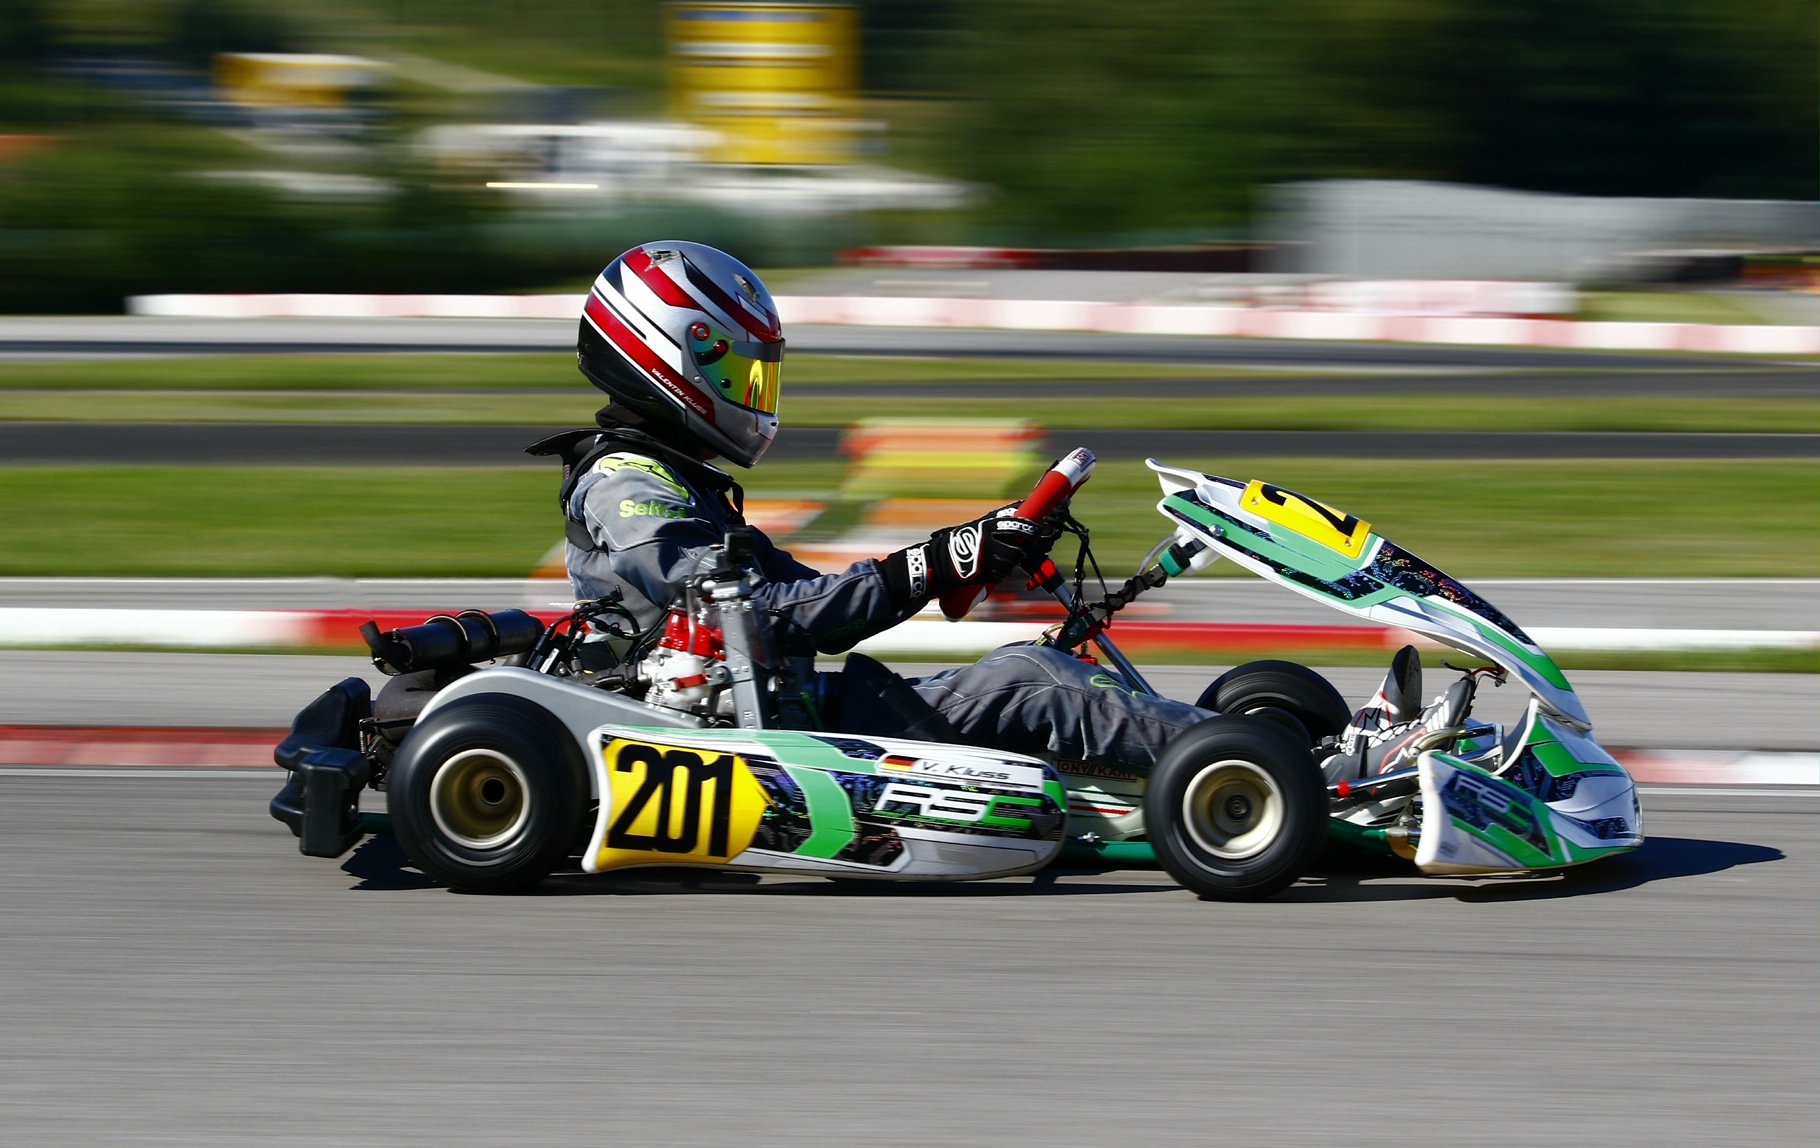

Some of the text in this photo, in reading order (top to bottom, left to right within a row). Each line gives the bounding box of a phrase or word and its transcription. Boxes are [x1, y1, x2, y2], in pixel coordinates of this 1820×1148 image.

[651, 368, 708, 415] VALENTIN KLUSS
[996, 520, 1035, 533] sparco
[1261, 484, 1359, 537] 2
[906, 547, 924, 598] sparco
[922, 761, 937, 773] V.
[945, 764, 1010, 780] Kluss
[606, 744, 734, 858] 201
